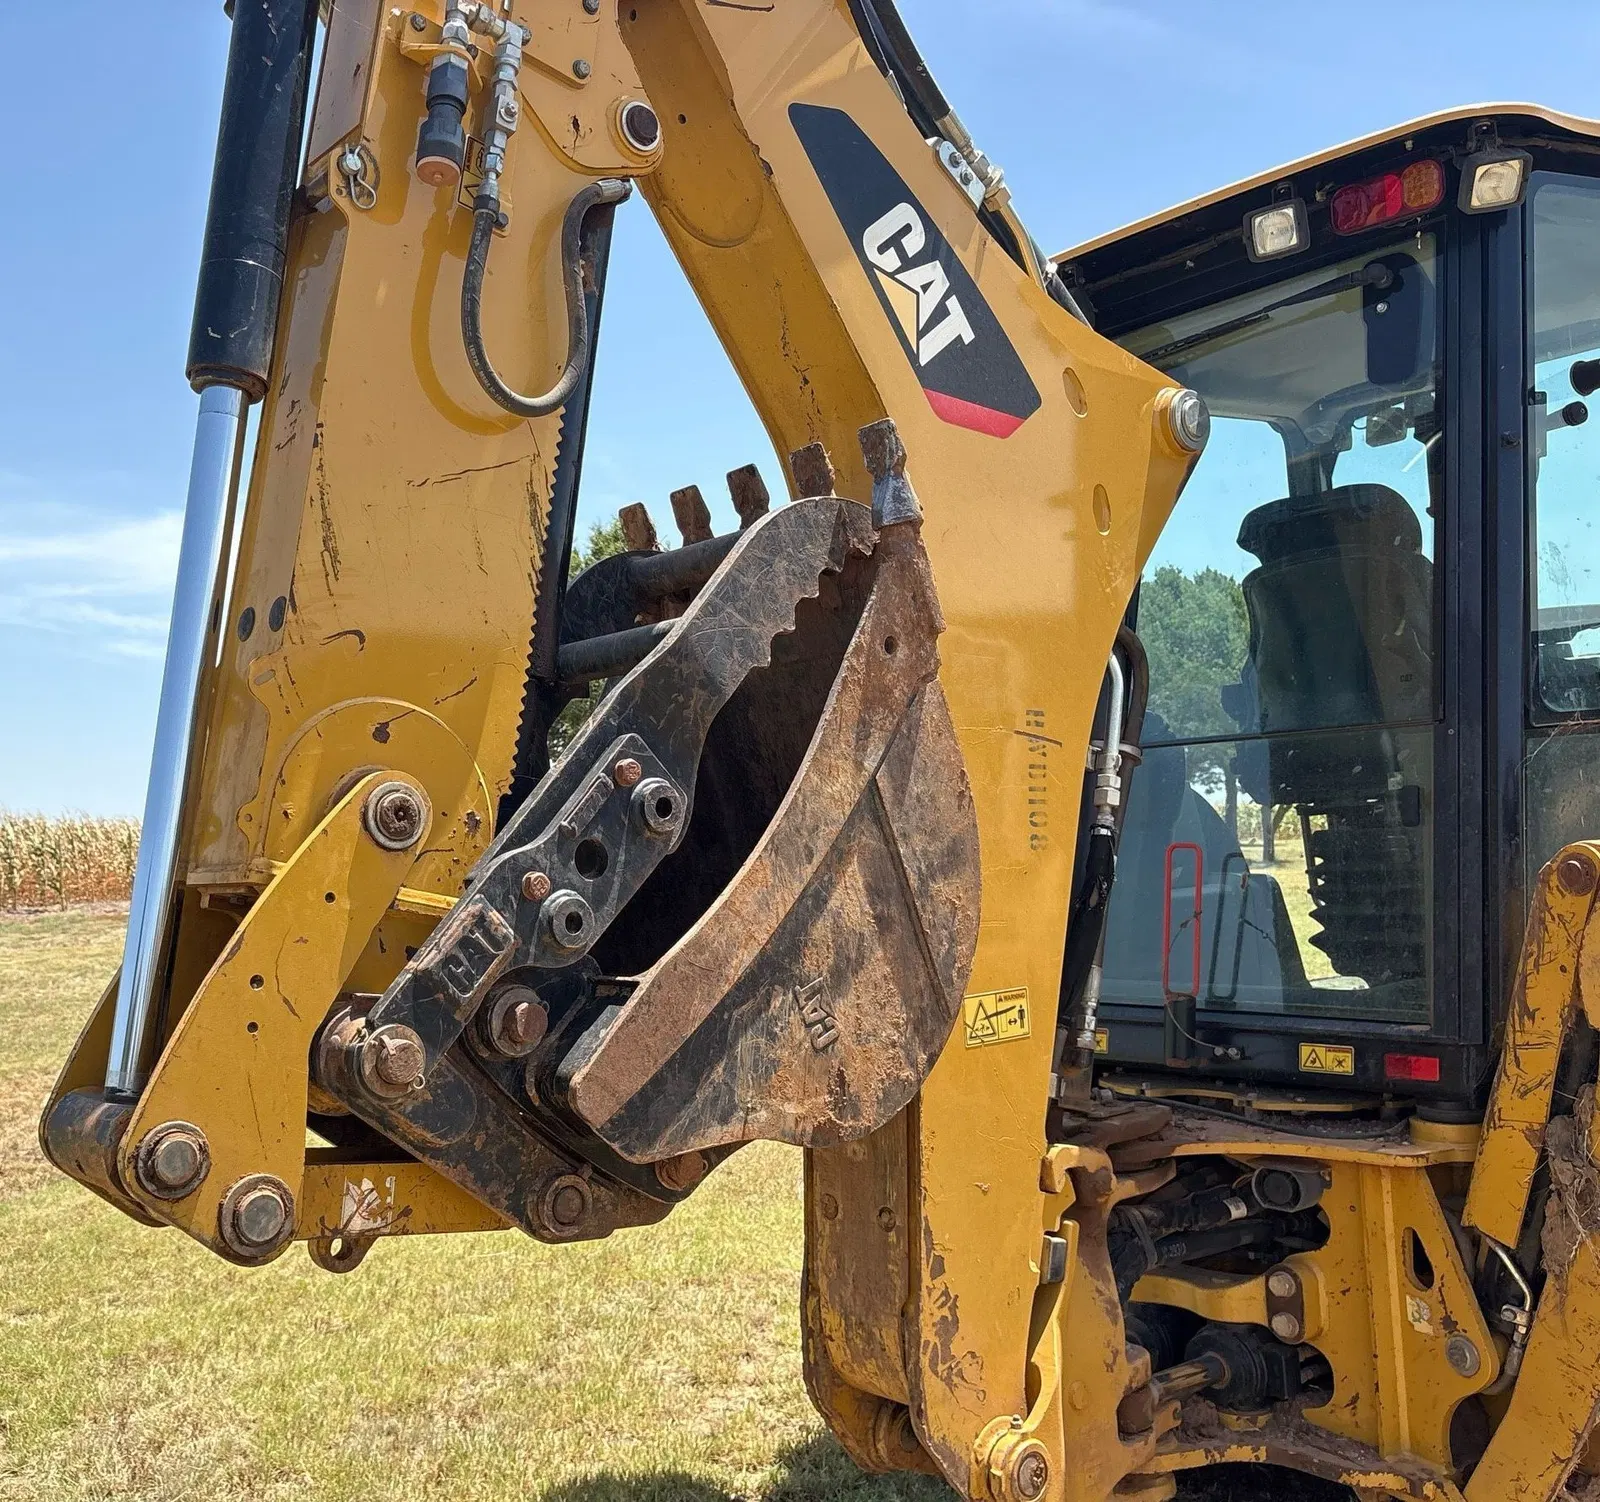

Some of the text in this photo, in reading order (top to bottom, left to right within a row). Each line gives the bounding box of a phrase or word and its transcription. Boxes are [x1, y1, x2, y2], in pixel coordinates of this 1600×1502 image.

[863, 202, 975, 367] CAT
[442, 913, 505, 997] CAT
[794, 977, 840, 1051] CAT
